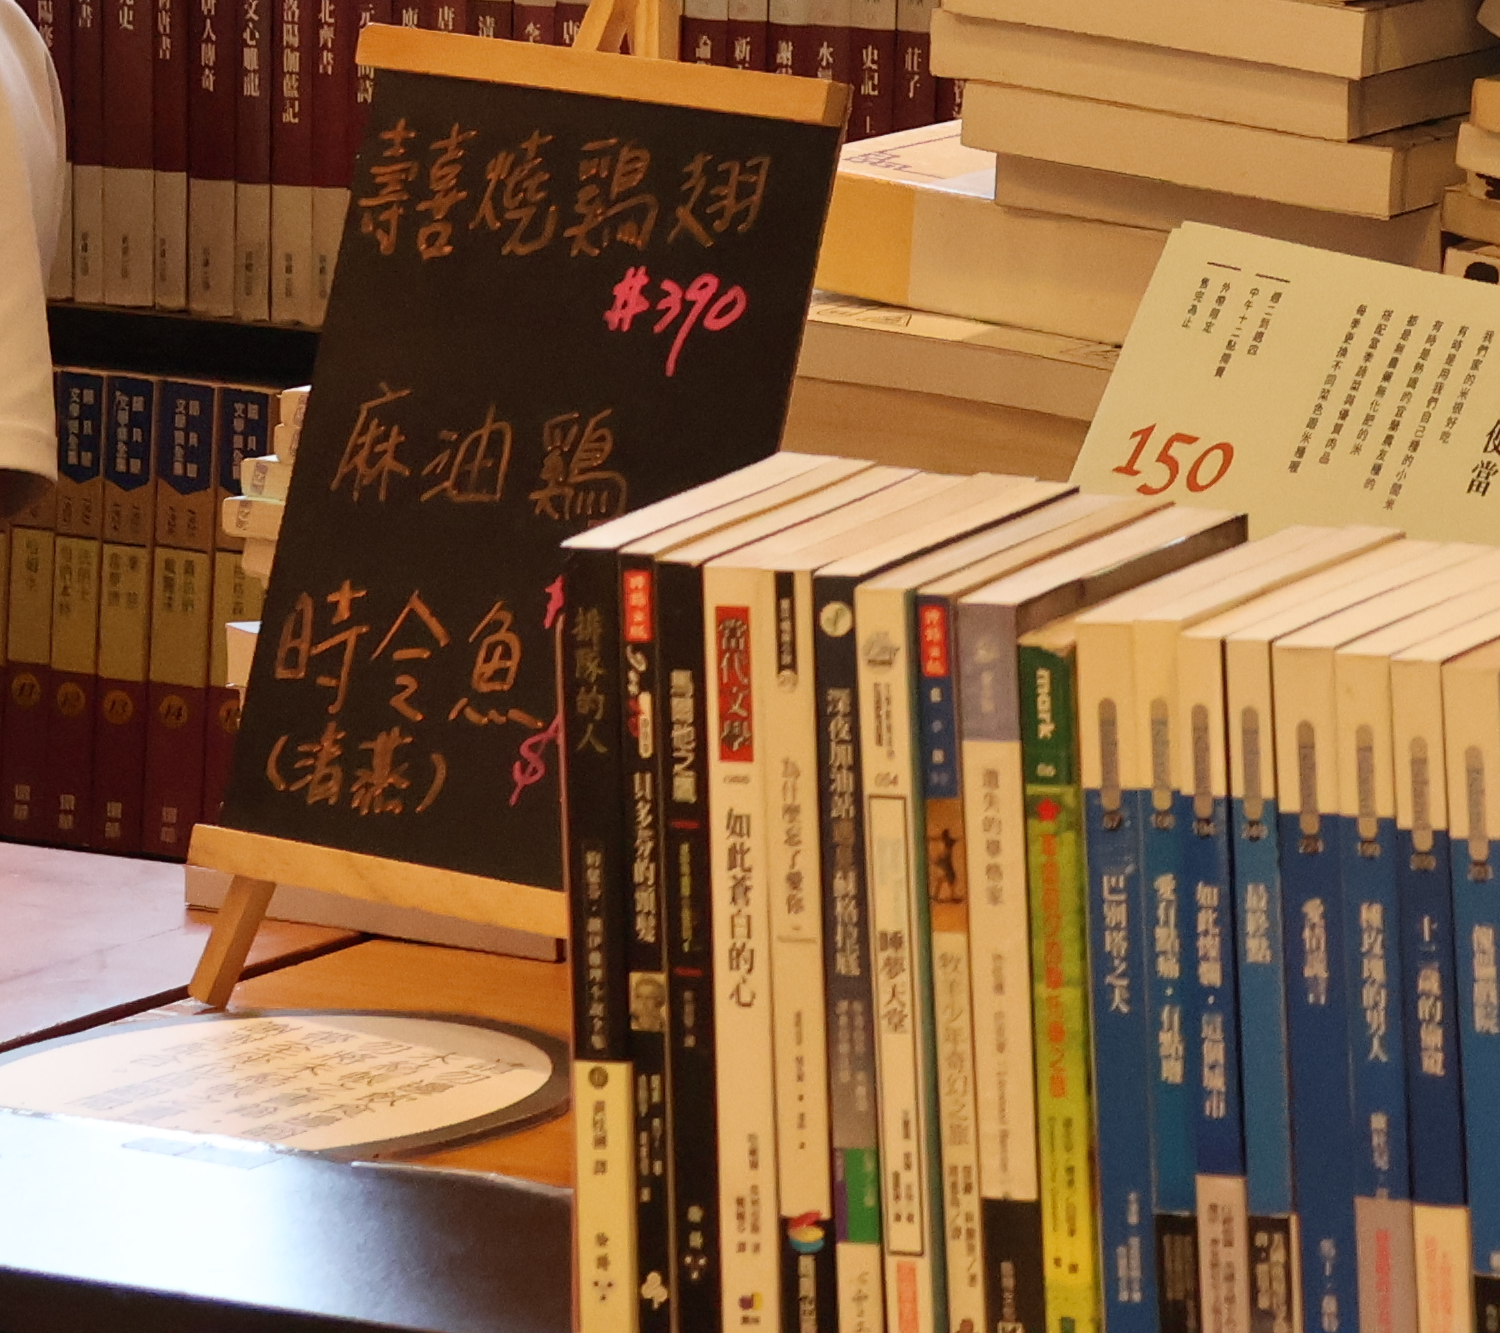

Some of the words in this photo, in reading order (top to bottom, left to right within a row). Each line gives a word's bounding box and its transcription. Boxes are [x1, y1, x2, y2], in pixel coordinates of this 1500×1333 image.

[860, 45, 879, 96] 史記
[1112, 422, 1234, 496] 150
[276, 579, 545, 728] 時令魚
[1035, 668, 1054, 740] mark
[725, 808, 756, 1008] 如此蒼白的心
